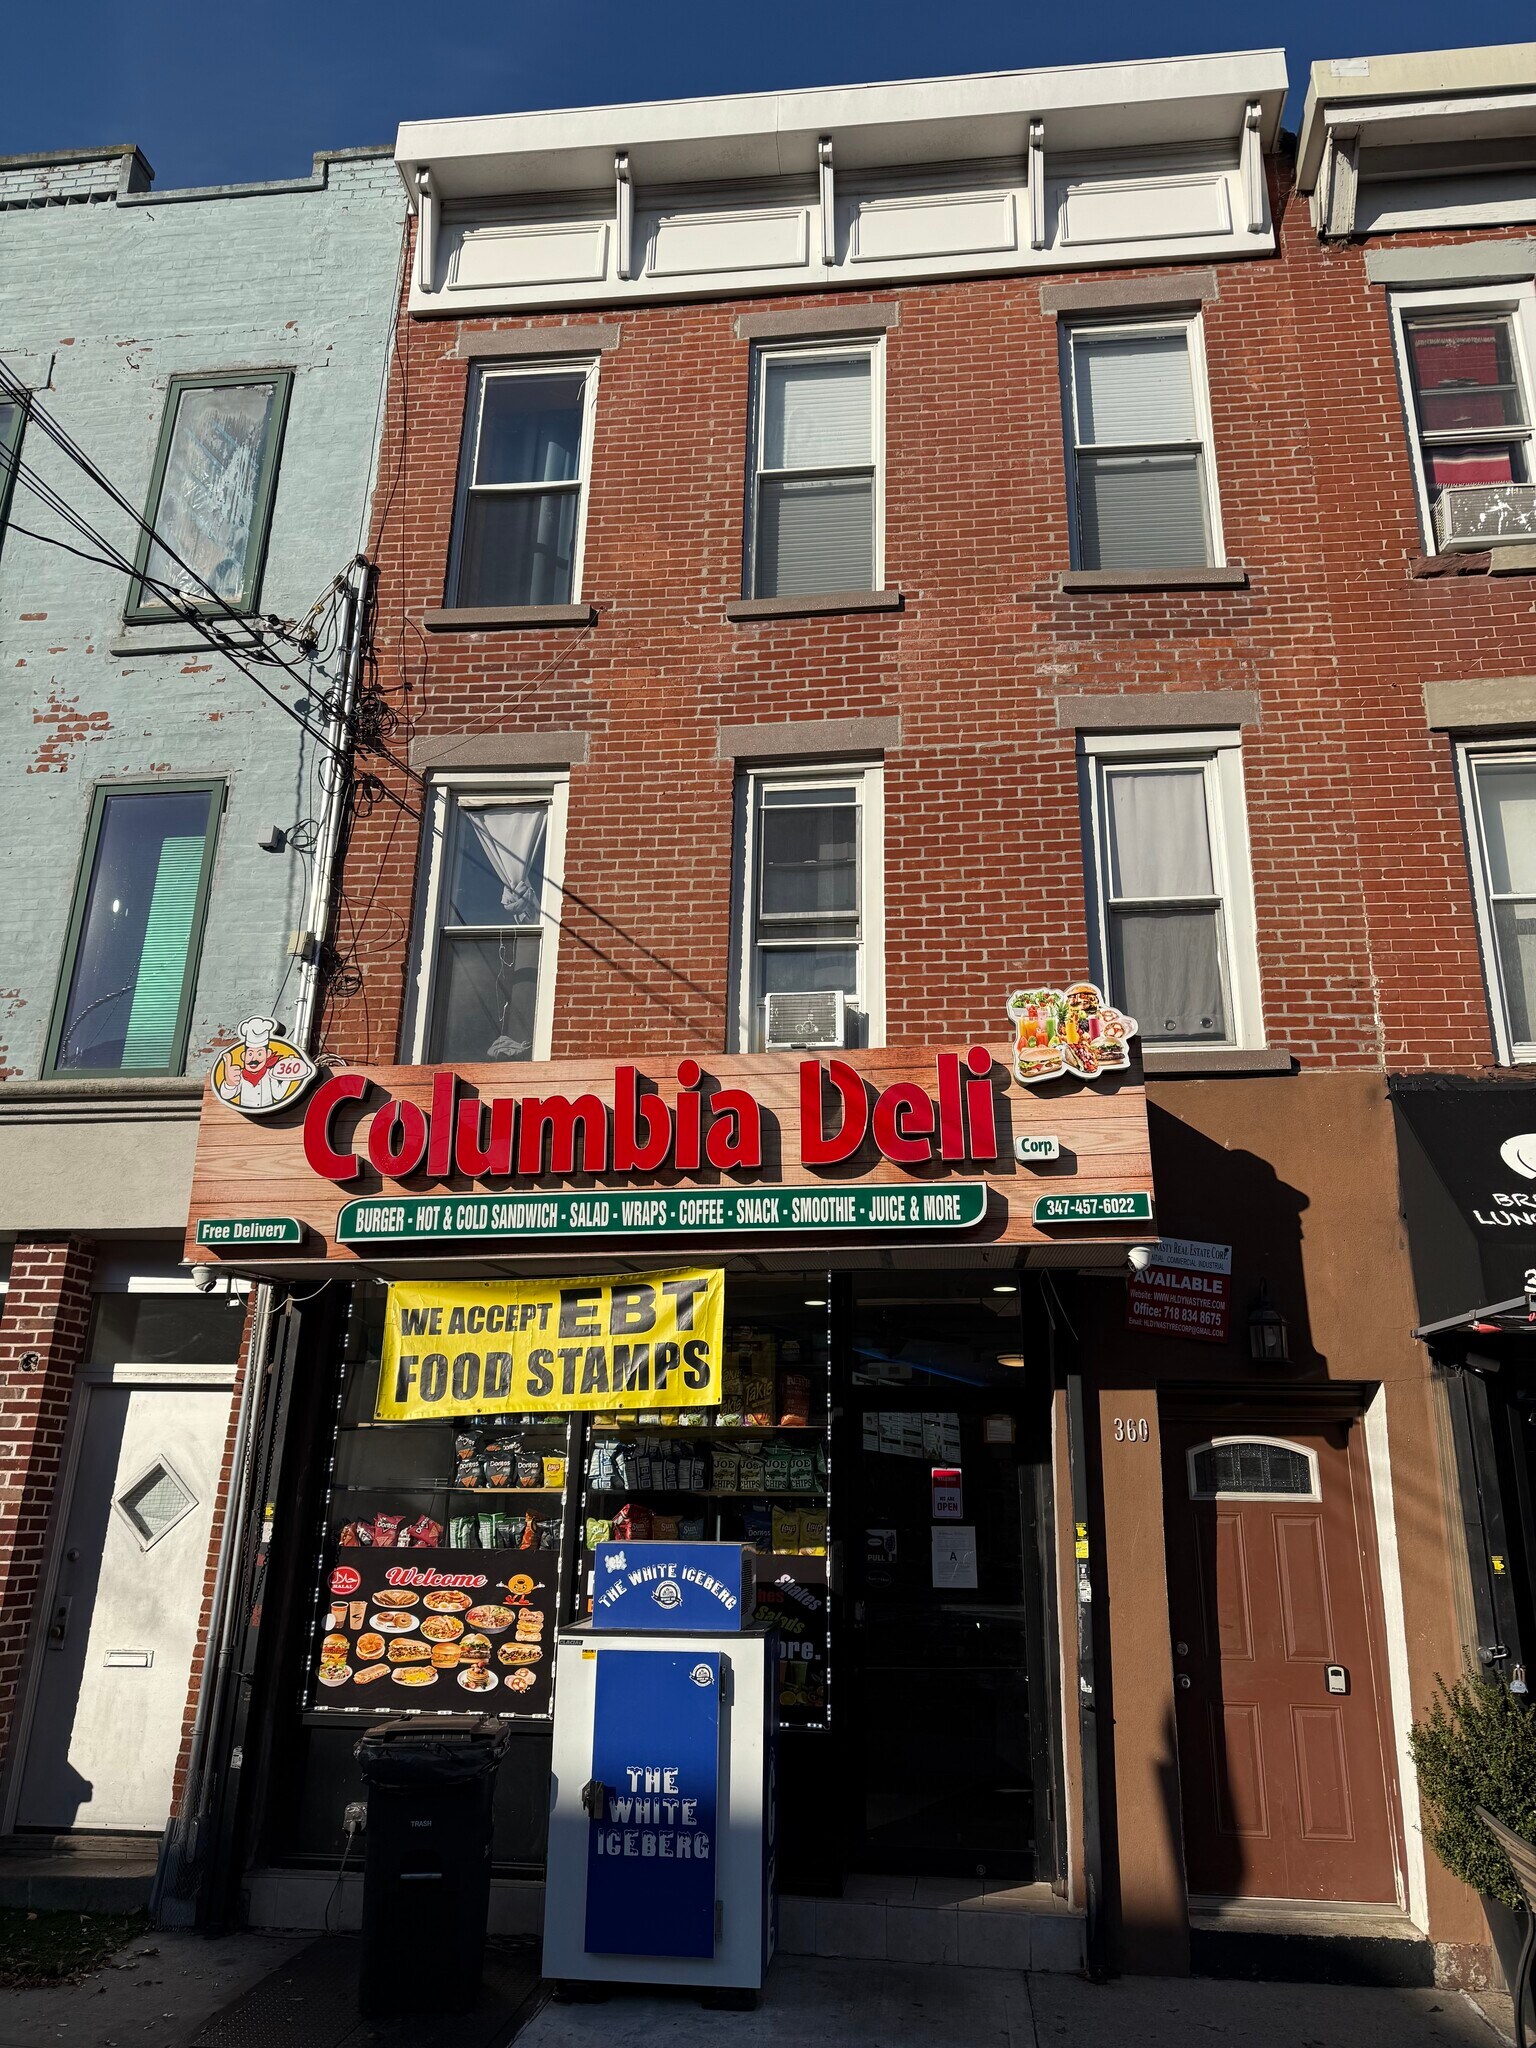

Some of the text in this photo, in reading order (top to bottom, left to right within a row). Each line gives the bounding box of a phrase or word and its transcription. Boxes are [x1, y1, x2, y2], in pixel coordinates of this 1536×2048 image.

[276, 1061, 301, 1076] 360
[303, 1046, 998, 1181] Columbia Deli
[1020, 1137, 1055, 1156] Corp.
[355, 1207, 405, 1233] BURGER
[416, 1206, 440, 1231] HOT
[456, 1205, 487, 1230] COLD
[491, 1203, 558, 1229] SANDWICH
[569, 1202, 609, 1227] SALAD
[621, 1200, 667, 1226] WRAPS
[679, 1199, 724, 1225] COFFEE
[736, 1198, 779, 1224] SNACK
[791, 1196, 856, 1223] SMOOTHIE
[869, 1195, 905, 1222] JUICE
[923, 1195, 961, 1221] MORE
[1047, 1197, 1135, 1216] 347-457-6022
[202, 1222, 286, 1240] Free Delivery
[1134, 1270, 1223, 1294] AVAILABLE
[1130, 1289, 1152, 1299] Website:
[401, 1279, 708, 1338] WE ACCEPT EBT
[1133, 1302, 1221, 1326] Office: 718 834 8675
[395, 1339, 711, 1403] FOOD STAMPS
[745, 1380, 773, 1405] Takis
[1114, 1417, 1149, 1443] 360
[490, 1460, 510, 1468] Doritos
[741, 1461, 760, 1469] JOE
[790, 1460, 810, 1468] JOE
[714, 1480, 735, 1488] CHIPS
[740, 1480, 760, 1489] CHIPS
[765, 1480, 787, 1489] CHIPS
[791, 1479, 812, 1488] CHIPS
[937, 1502, 958, 1511] OPEN
[661, 1523, 674, 1531] Sun
[683, 1525, 697, 1534] Sun
[950, 1552, 957, 1561] A
[385, 1566, 488, 1588] Welcome
[598, 1579, 627, 1608] THE
[627, 1563, 677, 1586] WHITE
[682, 1564, 738, 1610] ICEBERG
[774, 1574, 822, 1611] Shakes
[780, 1640, 822, 1661] ore.
[627, 1767, 679, 1794] THE
[609, 1797, 698, 1826] WHITE
[411, 1820, 432, 1828] TRASH
[597, 1828, 710, 1859] ICEBERG
